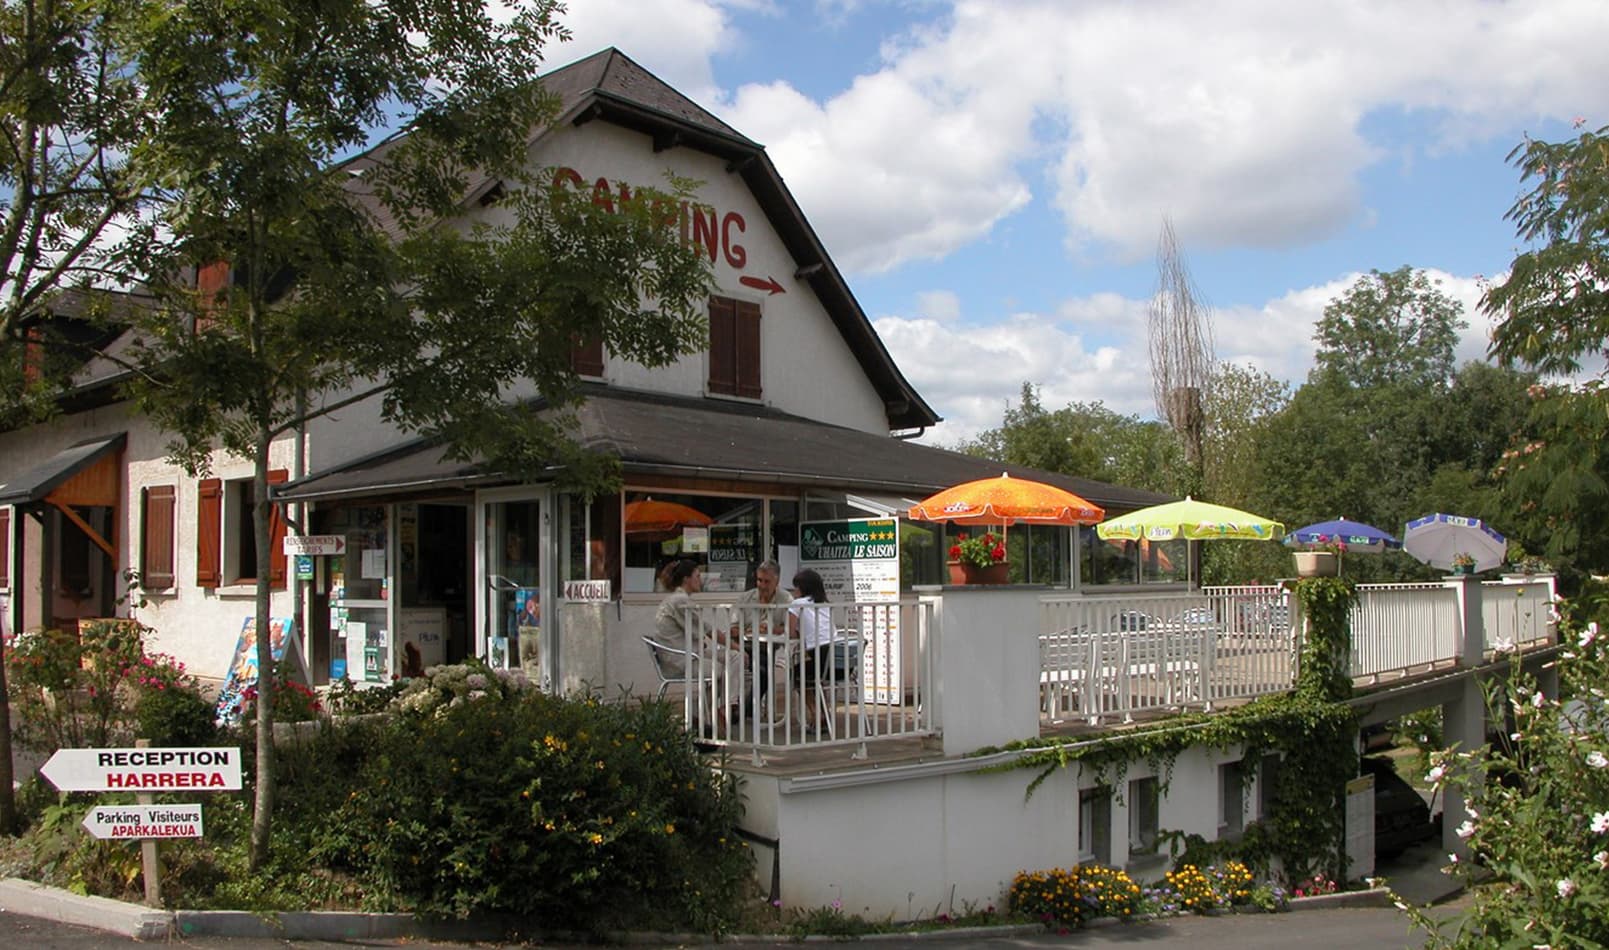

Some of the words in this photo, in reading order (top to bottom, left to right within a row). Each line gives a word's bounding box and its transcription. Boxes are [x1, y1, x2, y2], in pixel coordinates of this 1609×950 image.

[551, 166, 747, 270] CAPING
[827, 530, 868, 543] CAMPING
[854, 545, 865, 558] LE
[866, 543, 896, 557] SAISON
[573, 583, 608, 599] ACCUEIL
[98, 751, 229, 767] RECEPTION
[107, 772, 225, 788] HARRERA
[96, 811, 141, 825] Parking
[149, 811, 200, 823] Visiteurs
[112, 825, 196, 837] APARKALEKUA
